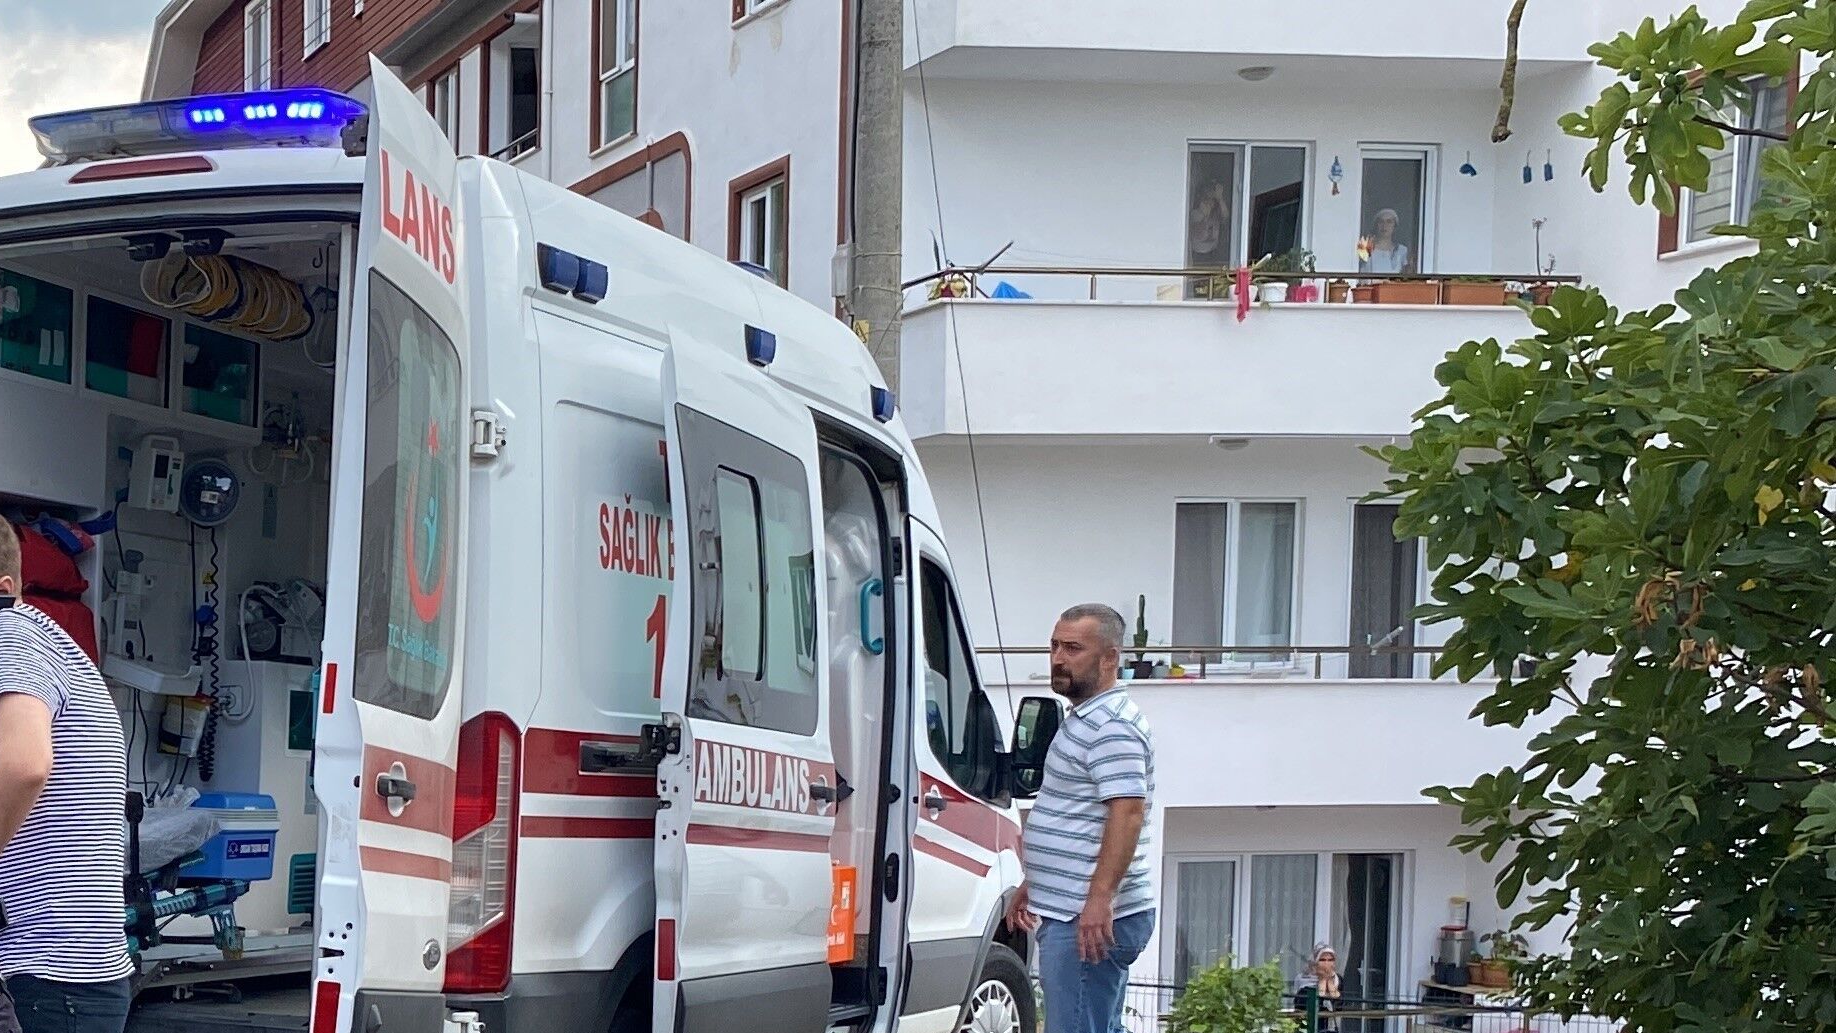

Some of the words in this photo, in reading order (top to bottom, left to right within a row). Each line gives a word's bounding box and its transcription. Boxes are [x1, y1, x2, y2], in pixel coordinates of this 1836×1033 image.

[381, 148, 455, 285] LANS
[599, 493, 662, 579] SAĞLIK
[695, 742, 811, 814] AMBULANS
